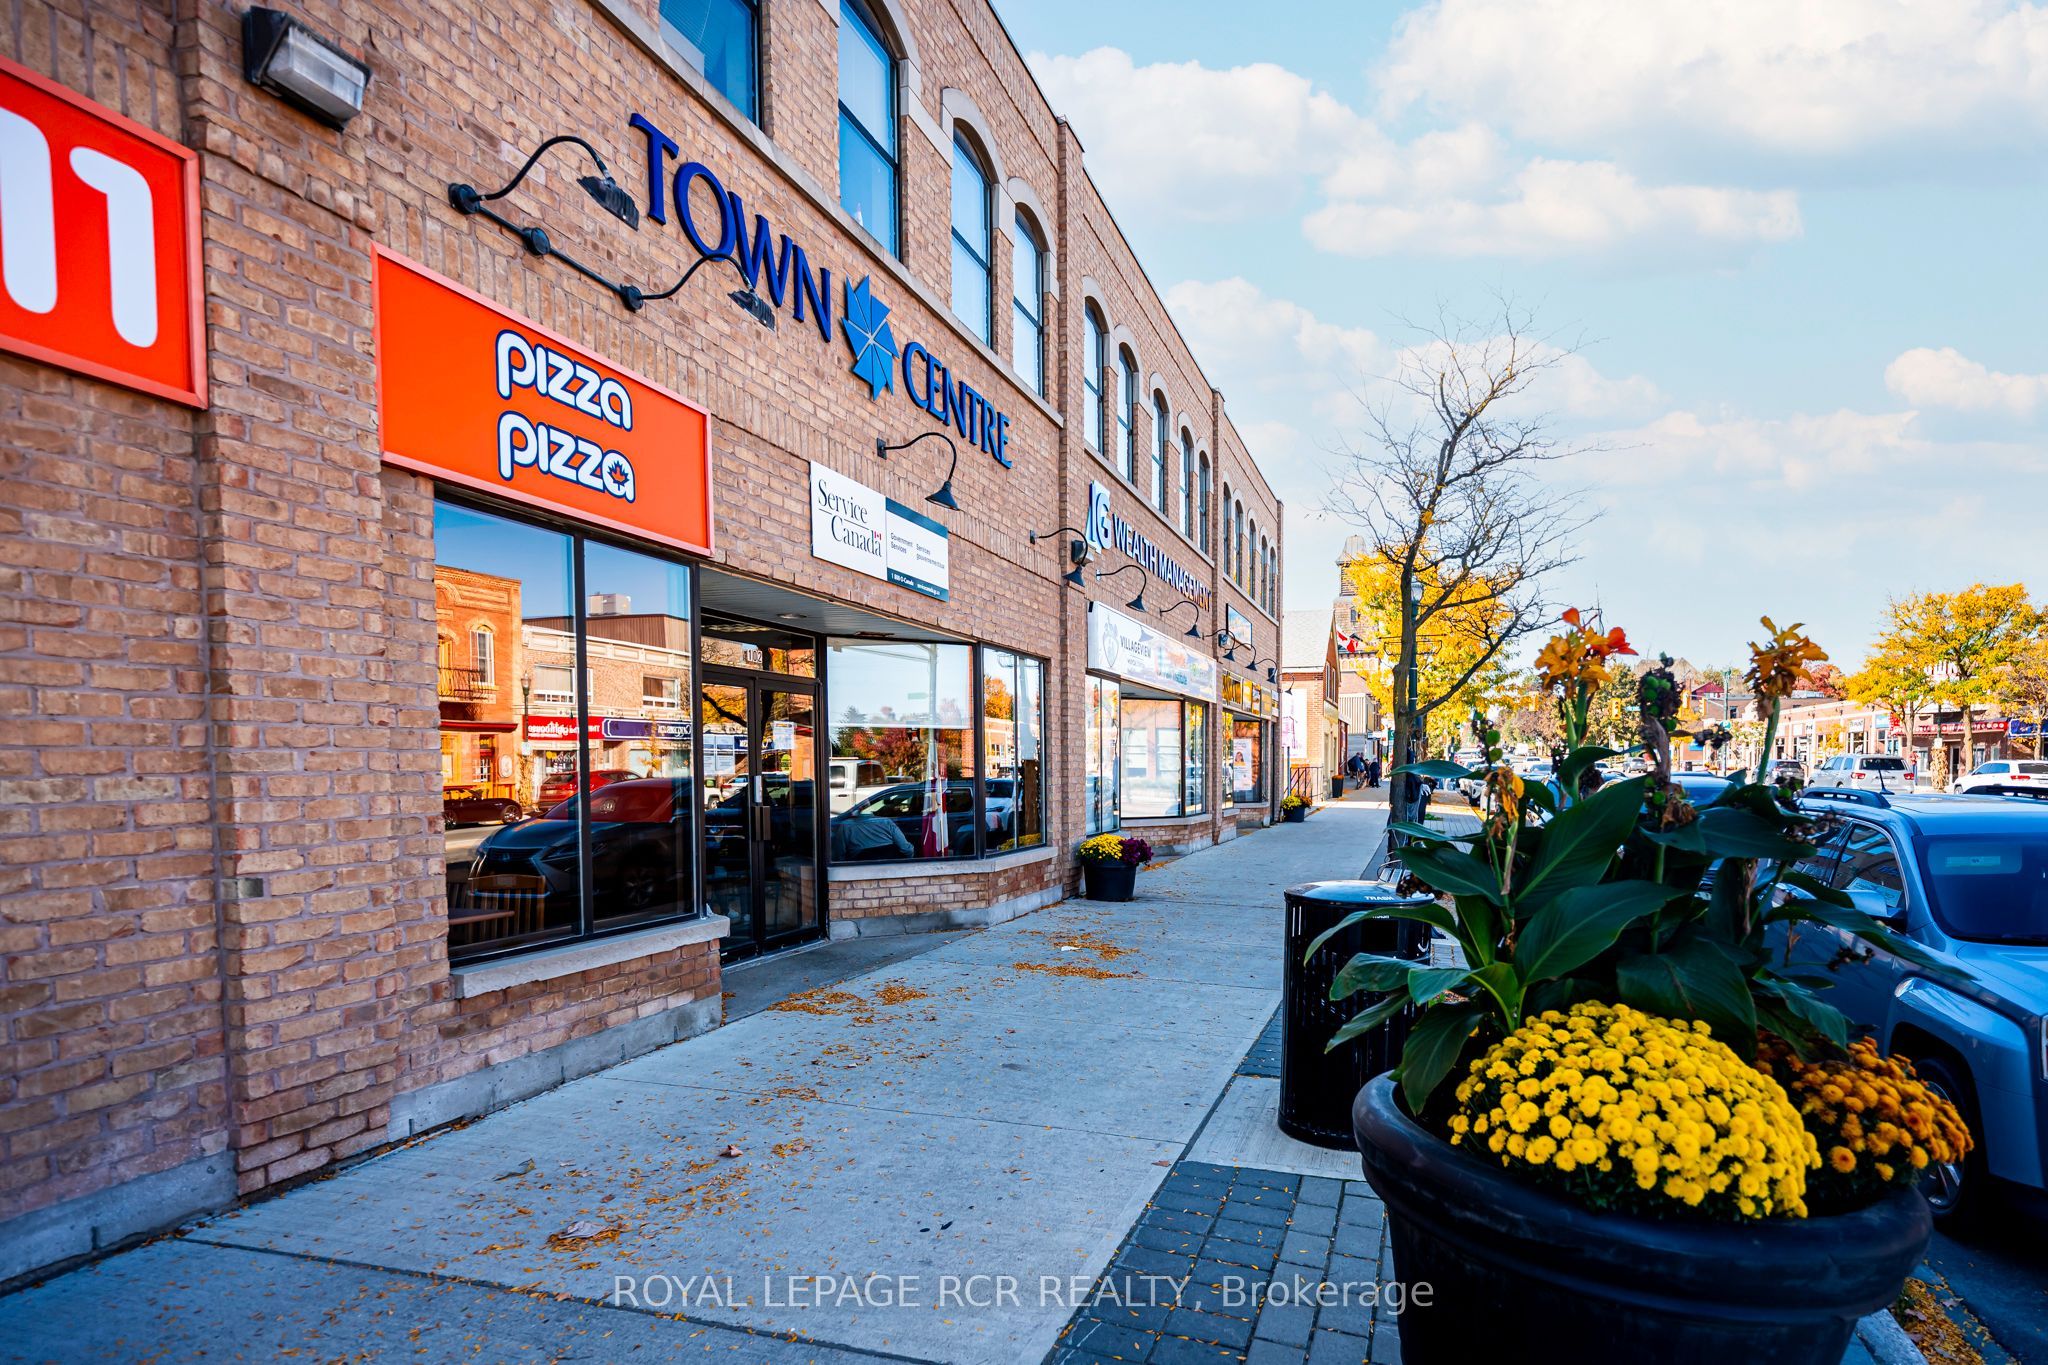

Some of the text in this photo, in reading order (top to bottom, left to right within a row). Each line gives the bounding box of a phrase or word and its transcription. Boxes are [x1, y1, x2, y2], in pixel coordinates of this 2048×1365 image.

[629, 113, 1013, 470] TOWN CENTRE
[818, 478, 868, 524] Service
[831, 514, 882, 557] Canada
[1086, 480, 1212, 613] IG WEALTH MANAGEMENT
